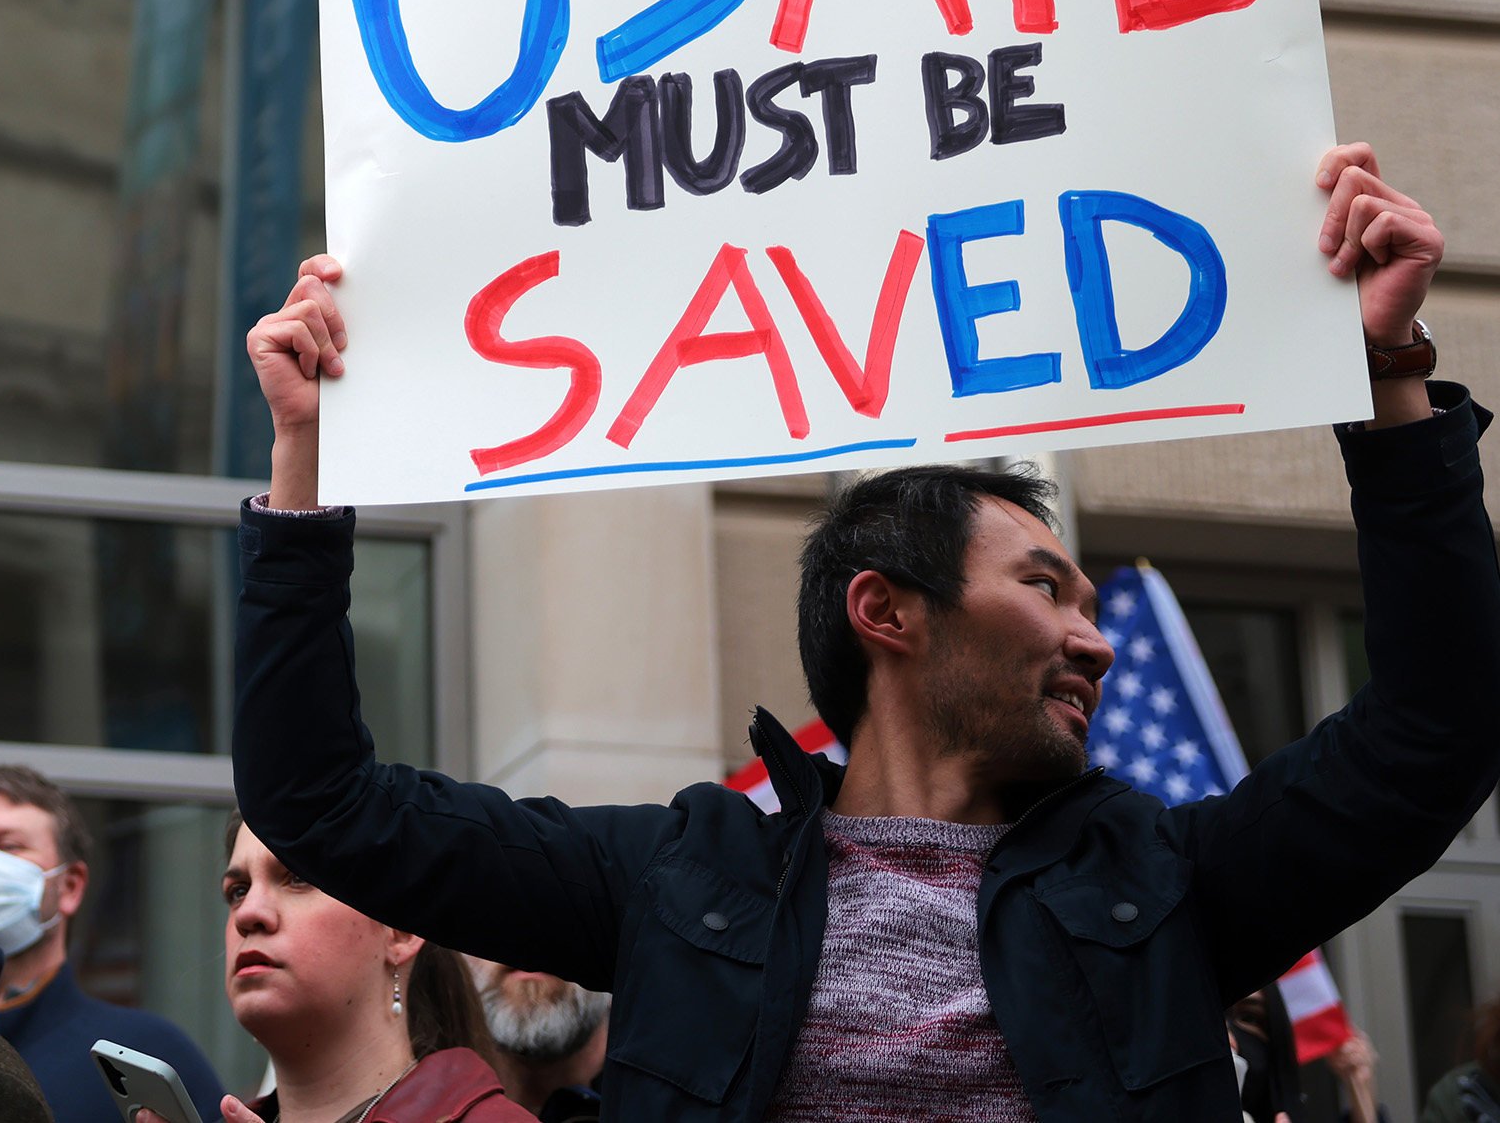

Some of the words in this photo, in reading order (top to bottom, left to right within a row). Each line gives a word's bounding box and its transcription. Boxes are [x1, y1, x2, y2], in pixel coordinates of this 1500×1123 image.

[547, 54, 877, 226] MUST
[921, 42, 1066, 160] BE
[463, 190, 1227, 473] SAVED
